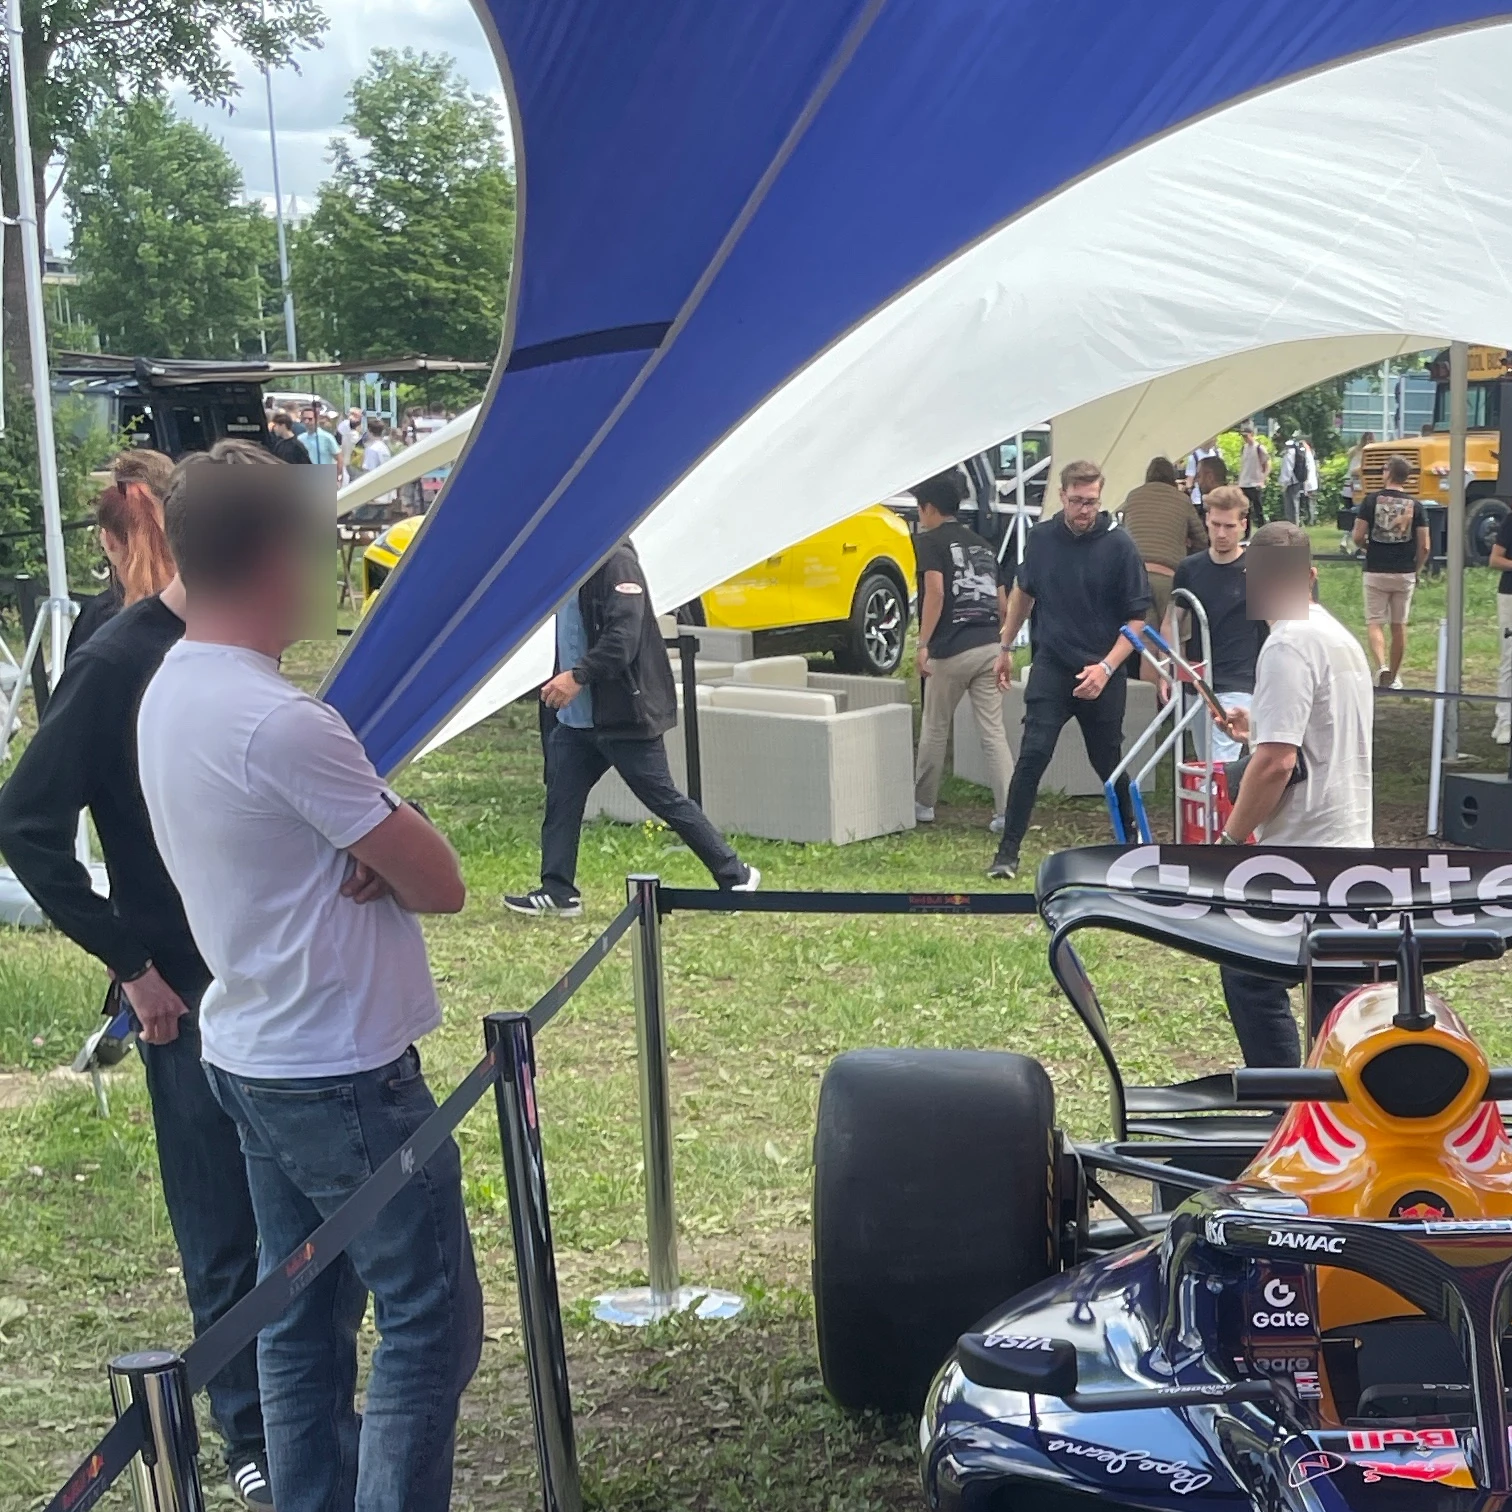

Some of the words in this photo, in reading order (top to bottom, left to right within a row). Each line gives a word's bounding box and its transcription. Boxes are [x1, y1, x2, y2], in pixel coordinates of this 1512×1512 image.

[1267, 1230, 1347, 1254] DAMAC
[1252, 1310, 1310, 1329] Gate
[983, 1333, 1054, 1352] VISA
[1347, 1428, 1460, 1452] Bull
[1048, 1439, 1152, 1475] Jeans
[1137, 1460, 1213, 1495] Pepe
